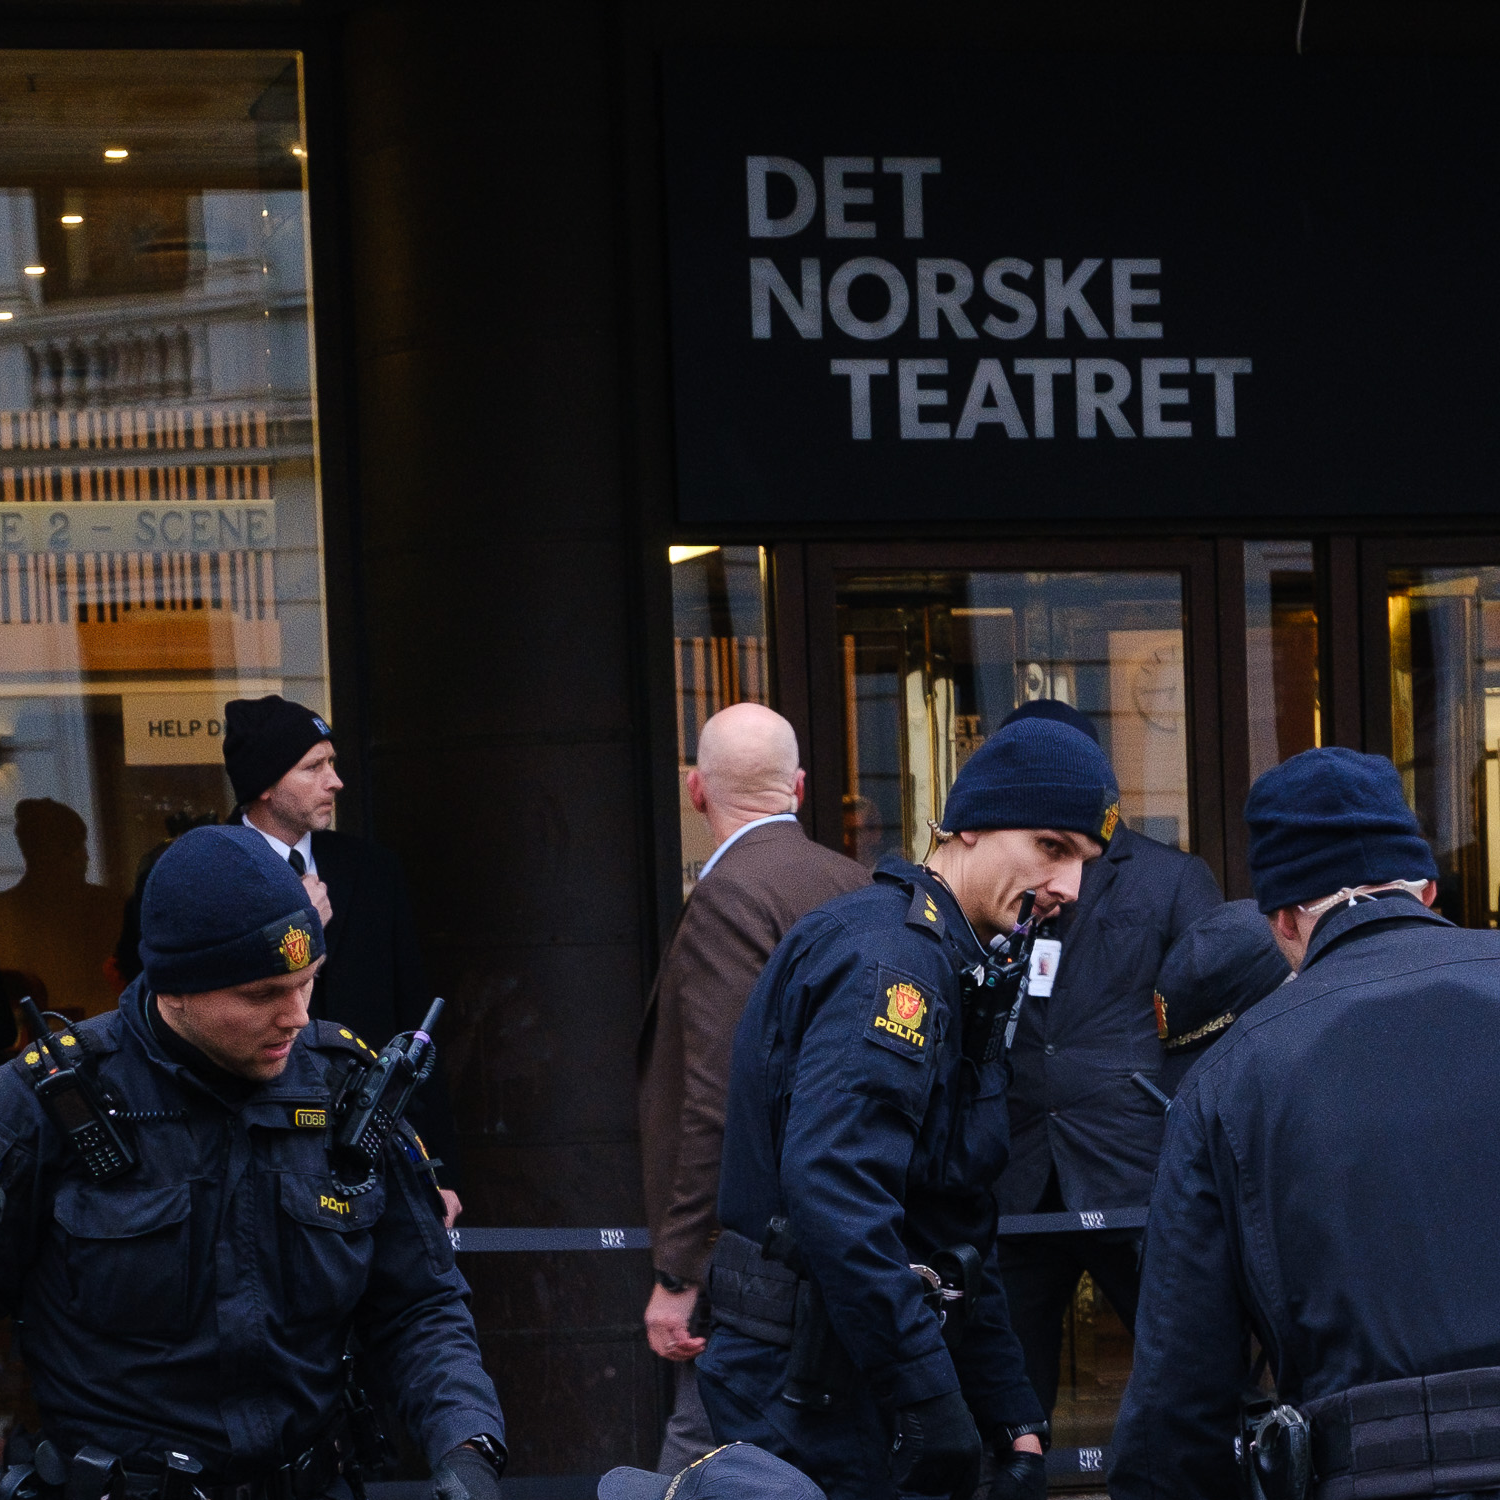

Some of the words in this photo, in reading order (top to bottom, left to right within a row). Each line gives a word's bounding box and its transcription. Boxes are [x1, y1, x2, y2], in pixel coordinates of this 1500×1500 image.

[746, 156, 941, 239] DET
[750, 257, 1164, 340] NORSKE
[831, 357, 1253, 440] TEATRET
[50, 513, 71, 548] 2
[134, 509, 268, 546] SCENE
[148, 720, 201, 737] HELP
[874, 1016, 925, 1047] POLITI
